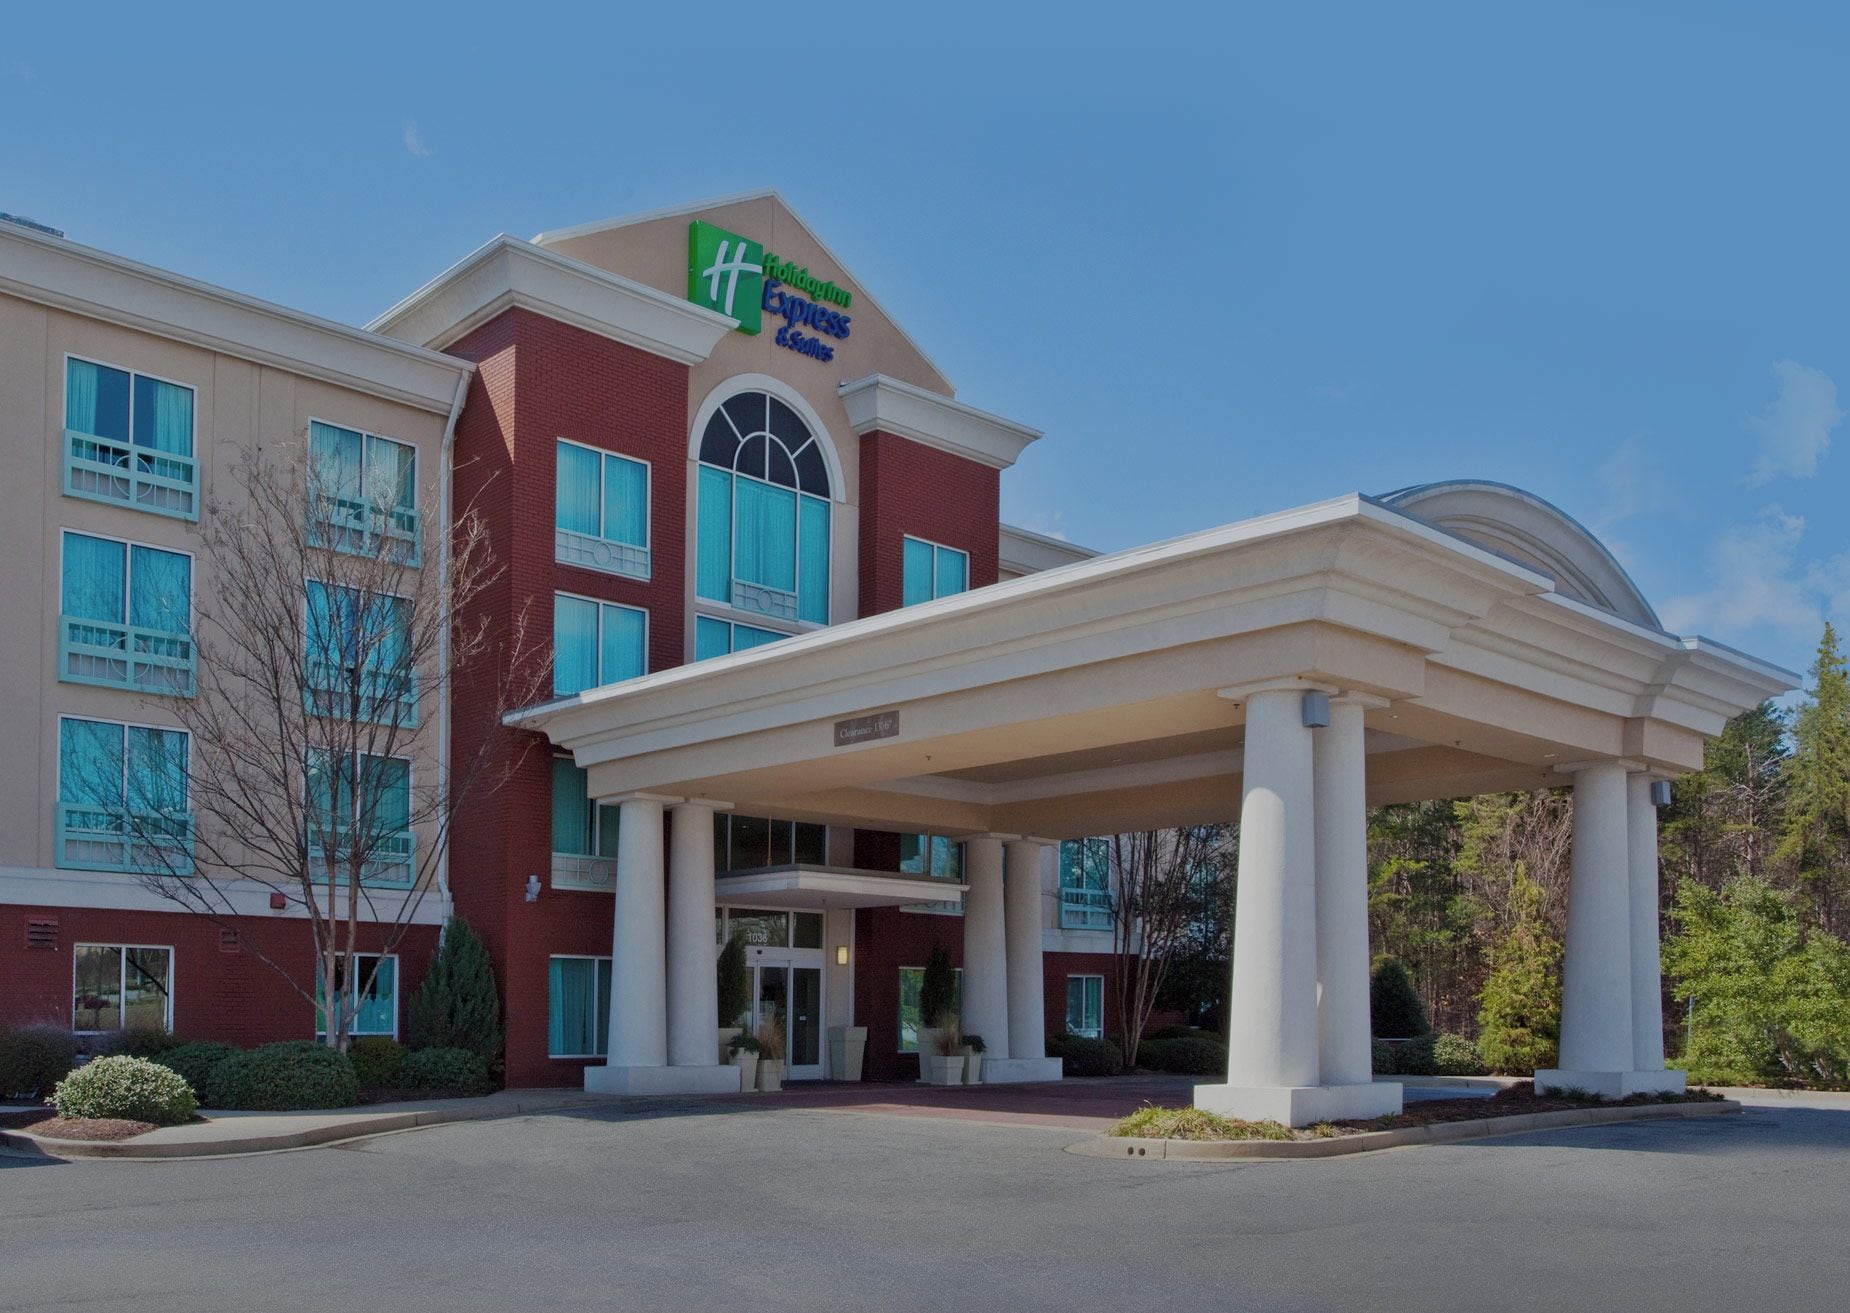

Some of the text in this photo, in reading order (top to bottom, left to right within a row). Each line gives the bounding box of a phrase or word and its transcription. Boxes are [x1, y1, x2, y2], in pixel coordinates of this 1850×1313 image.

[763, 252, 852, 308] Holiday Inn
[761, 278, 851, 340] Express
[775, 325, 834, 362] & Suites
